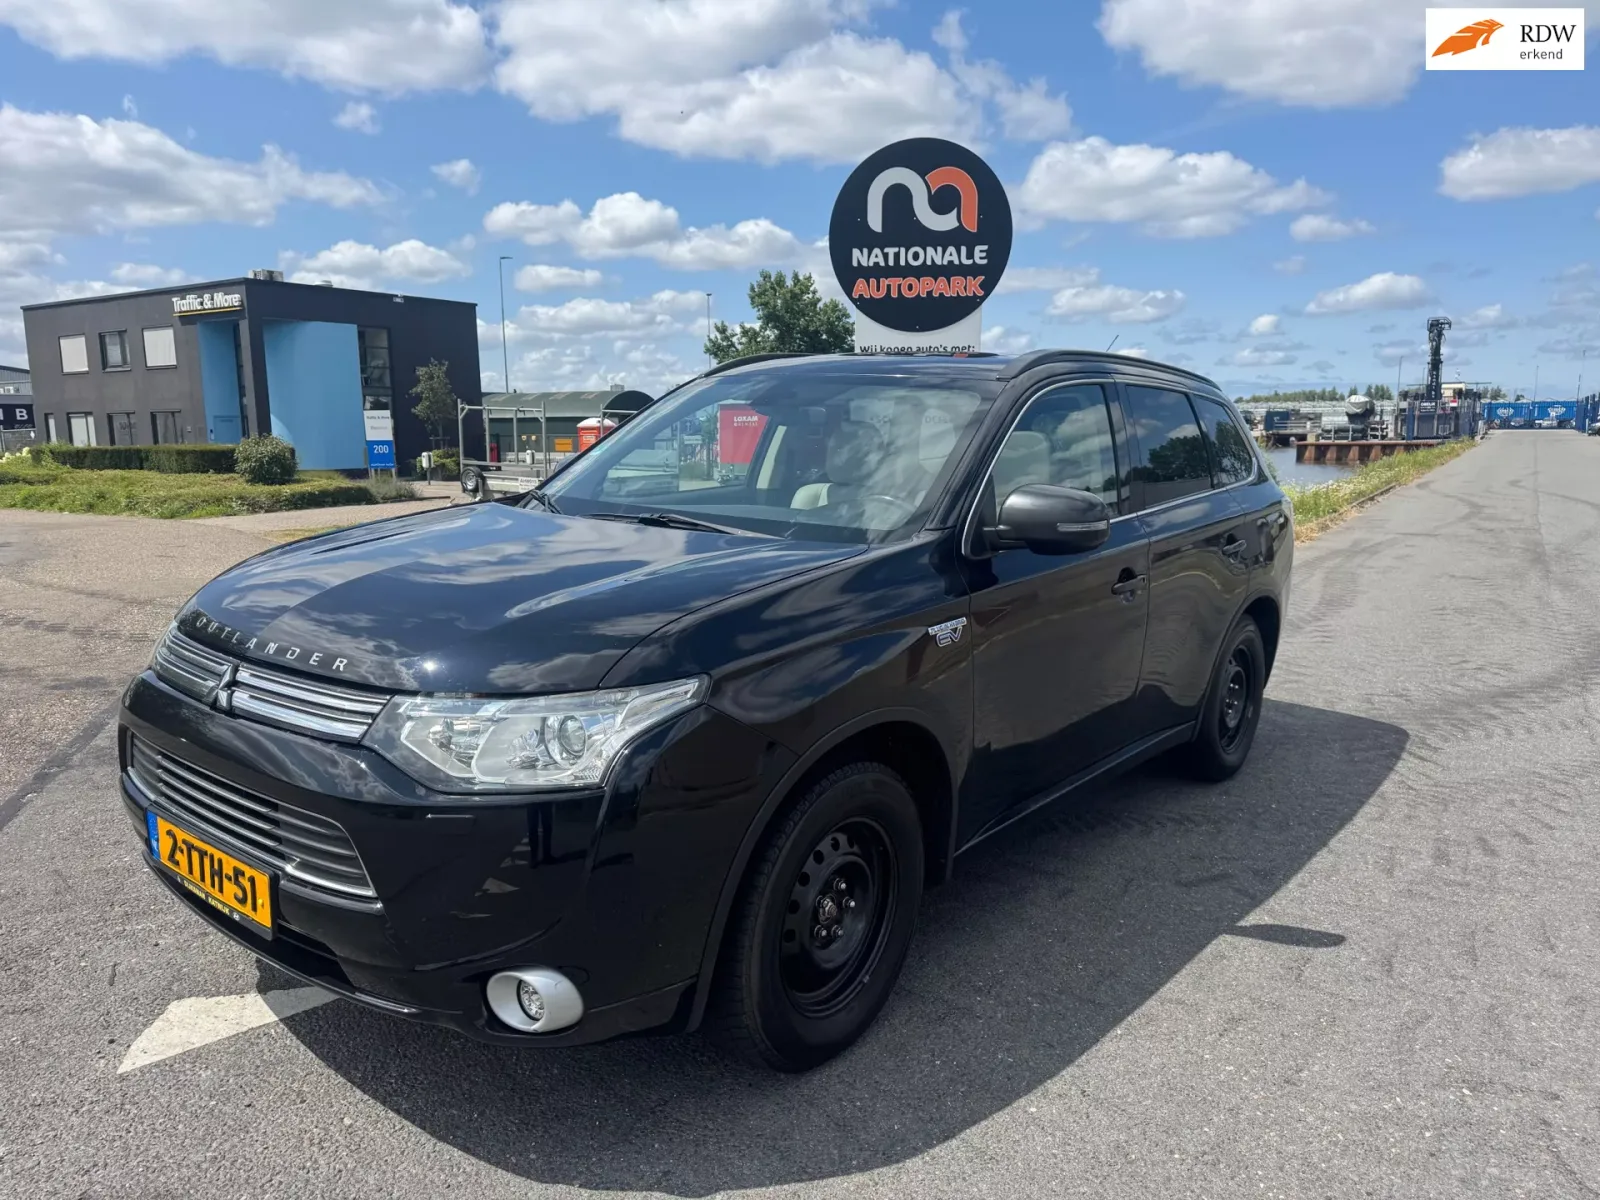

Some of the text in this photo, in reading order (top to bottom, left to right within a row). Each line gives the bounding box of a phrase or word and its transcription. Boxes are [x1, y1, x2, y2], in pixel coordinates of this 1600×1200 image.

[852, 245, 989, 267] NATIONALE
[852, 276, 985, 298] AUTOPARK
[172, 292, 241, 312] Traffic & More
[951, 344, 975, 353] met:
[373, 445, 389, 453] 200
[196, 617, 348, 671] OUTLANDER
[936, 626, 962, 647] EV
[166, 829, 258, 913] 2-TTH-51
